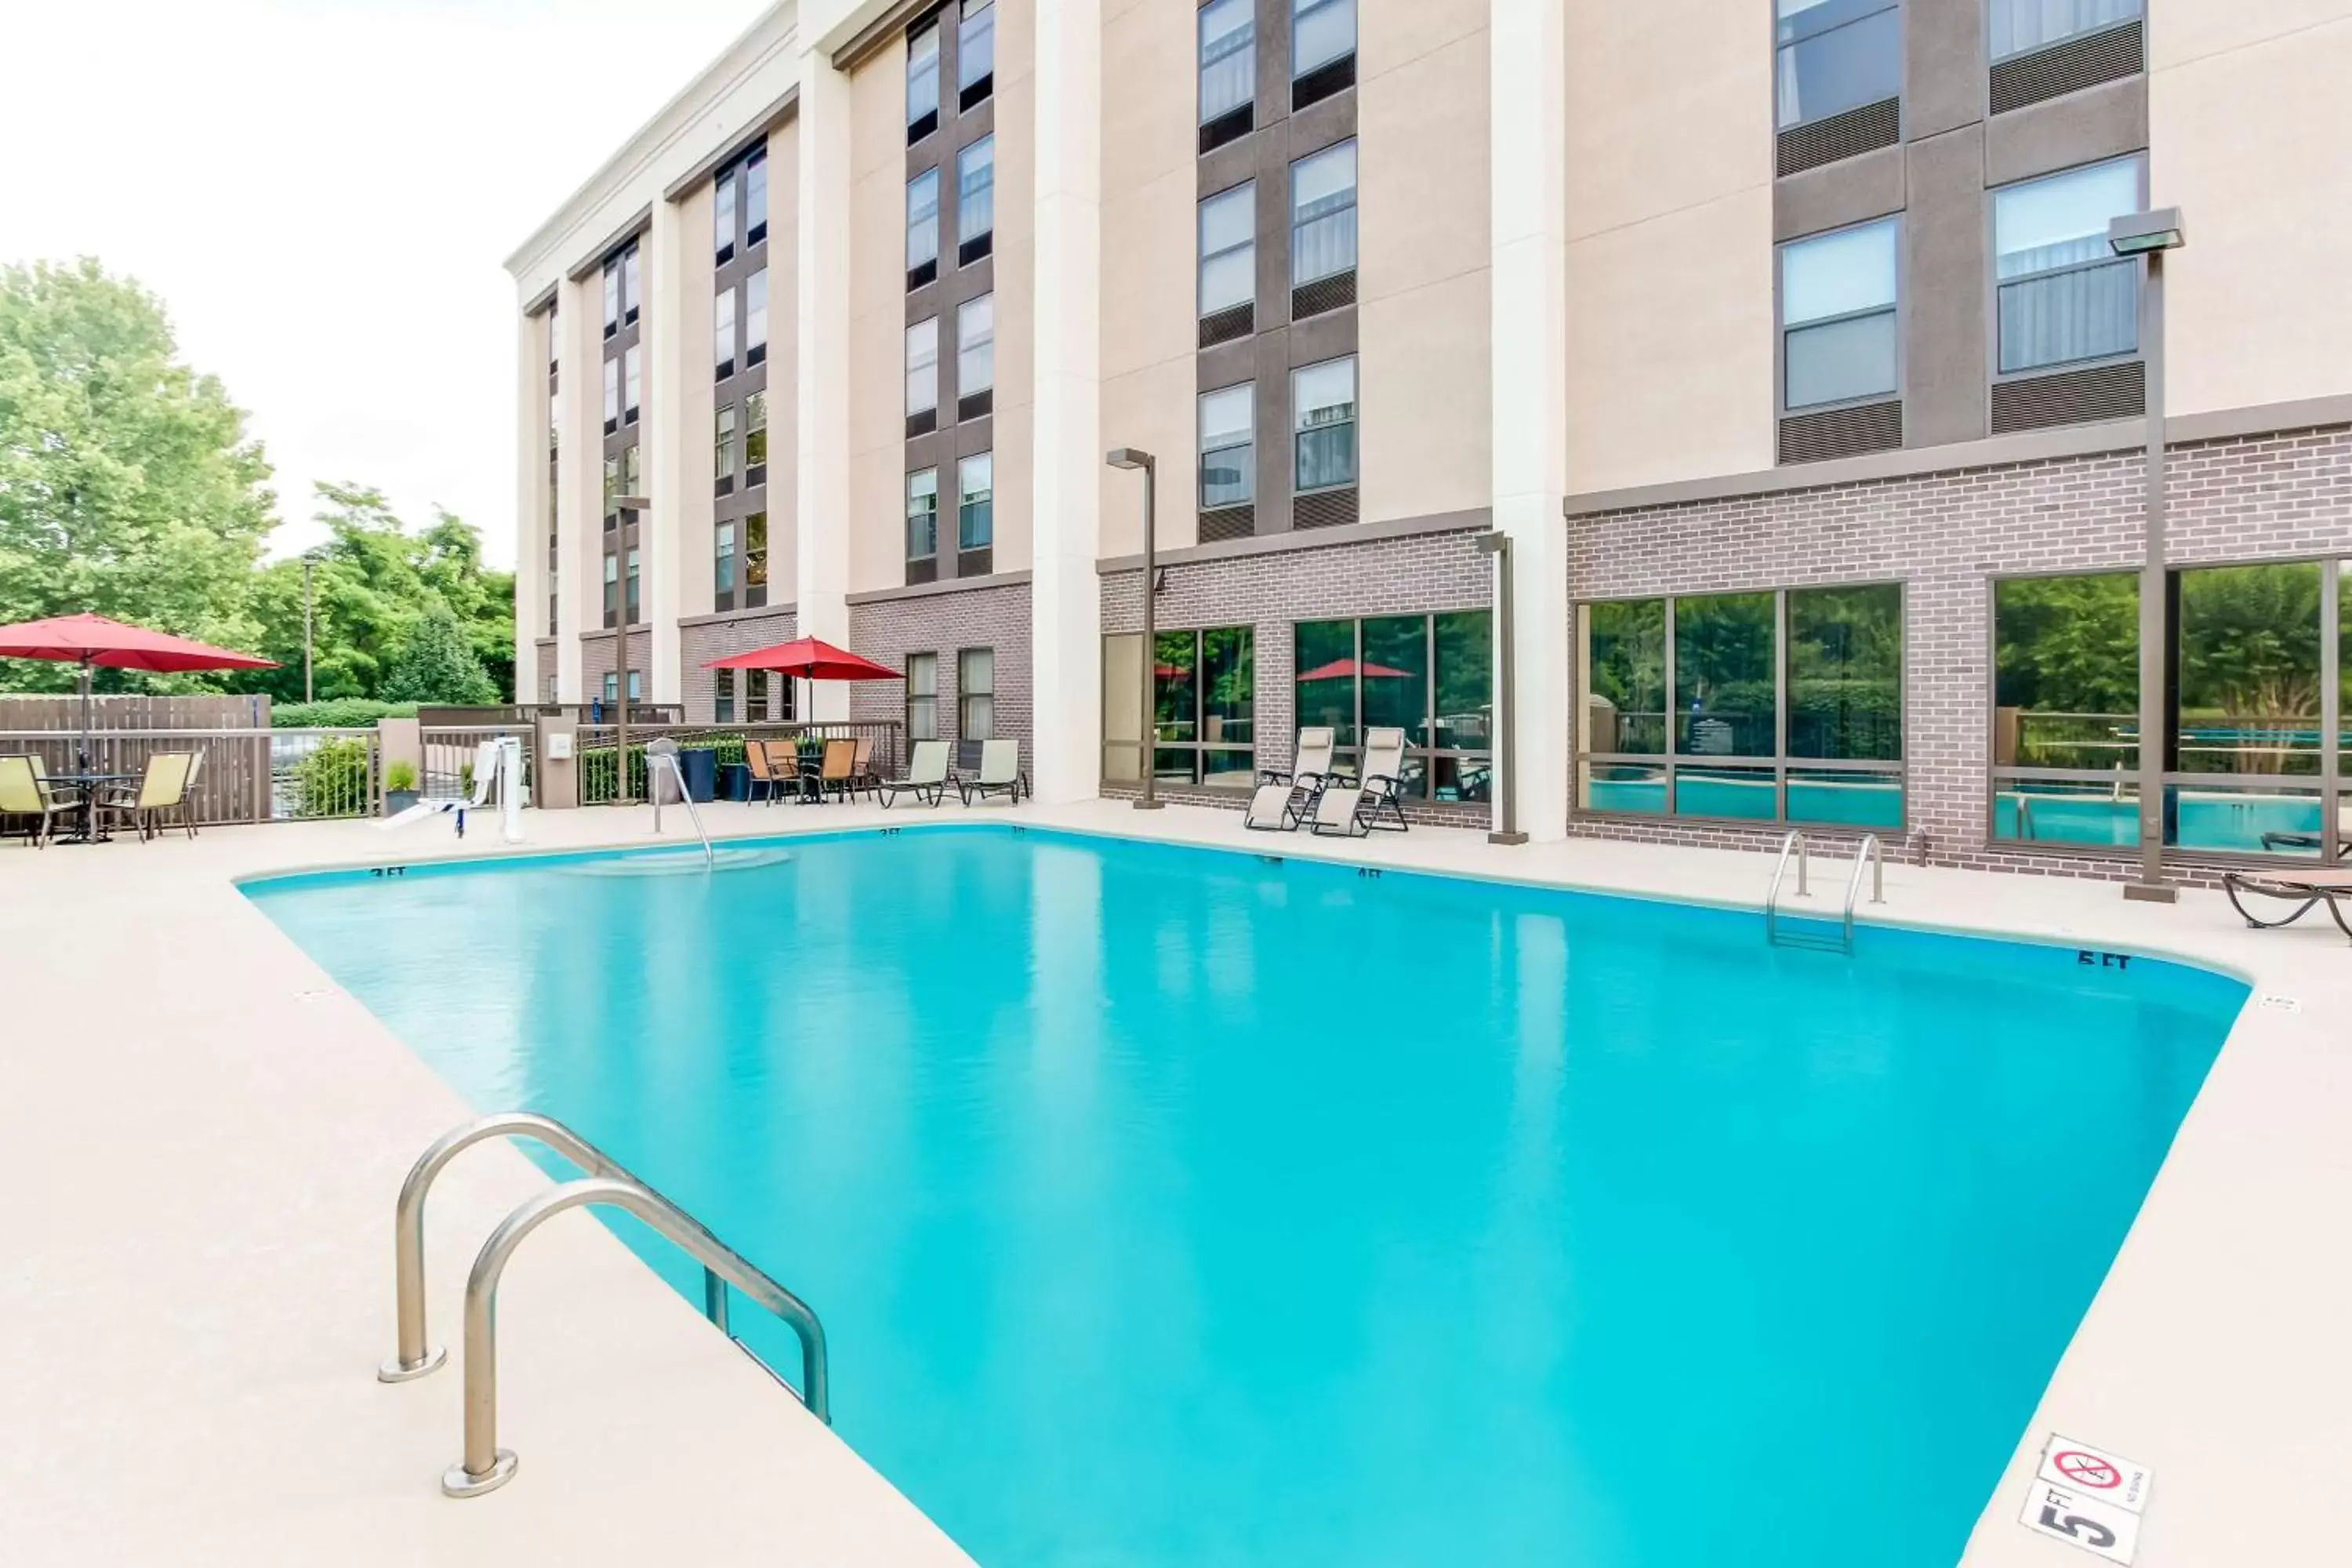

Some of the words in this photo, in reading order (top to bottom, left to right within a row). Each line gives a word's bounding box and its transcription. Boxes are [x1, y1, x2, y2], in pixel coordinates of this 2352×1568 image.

[2078, 949, 2096, 966] 5
[2045, 1488, 2073, 1509] FT
[2038, 1504, 2116, 1548] 5
